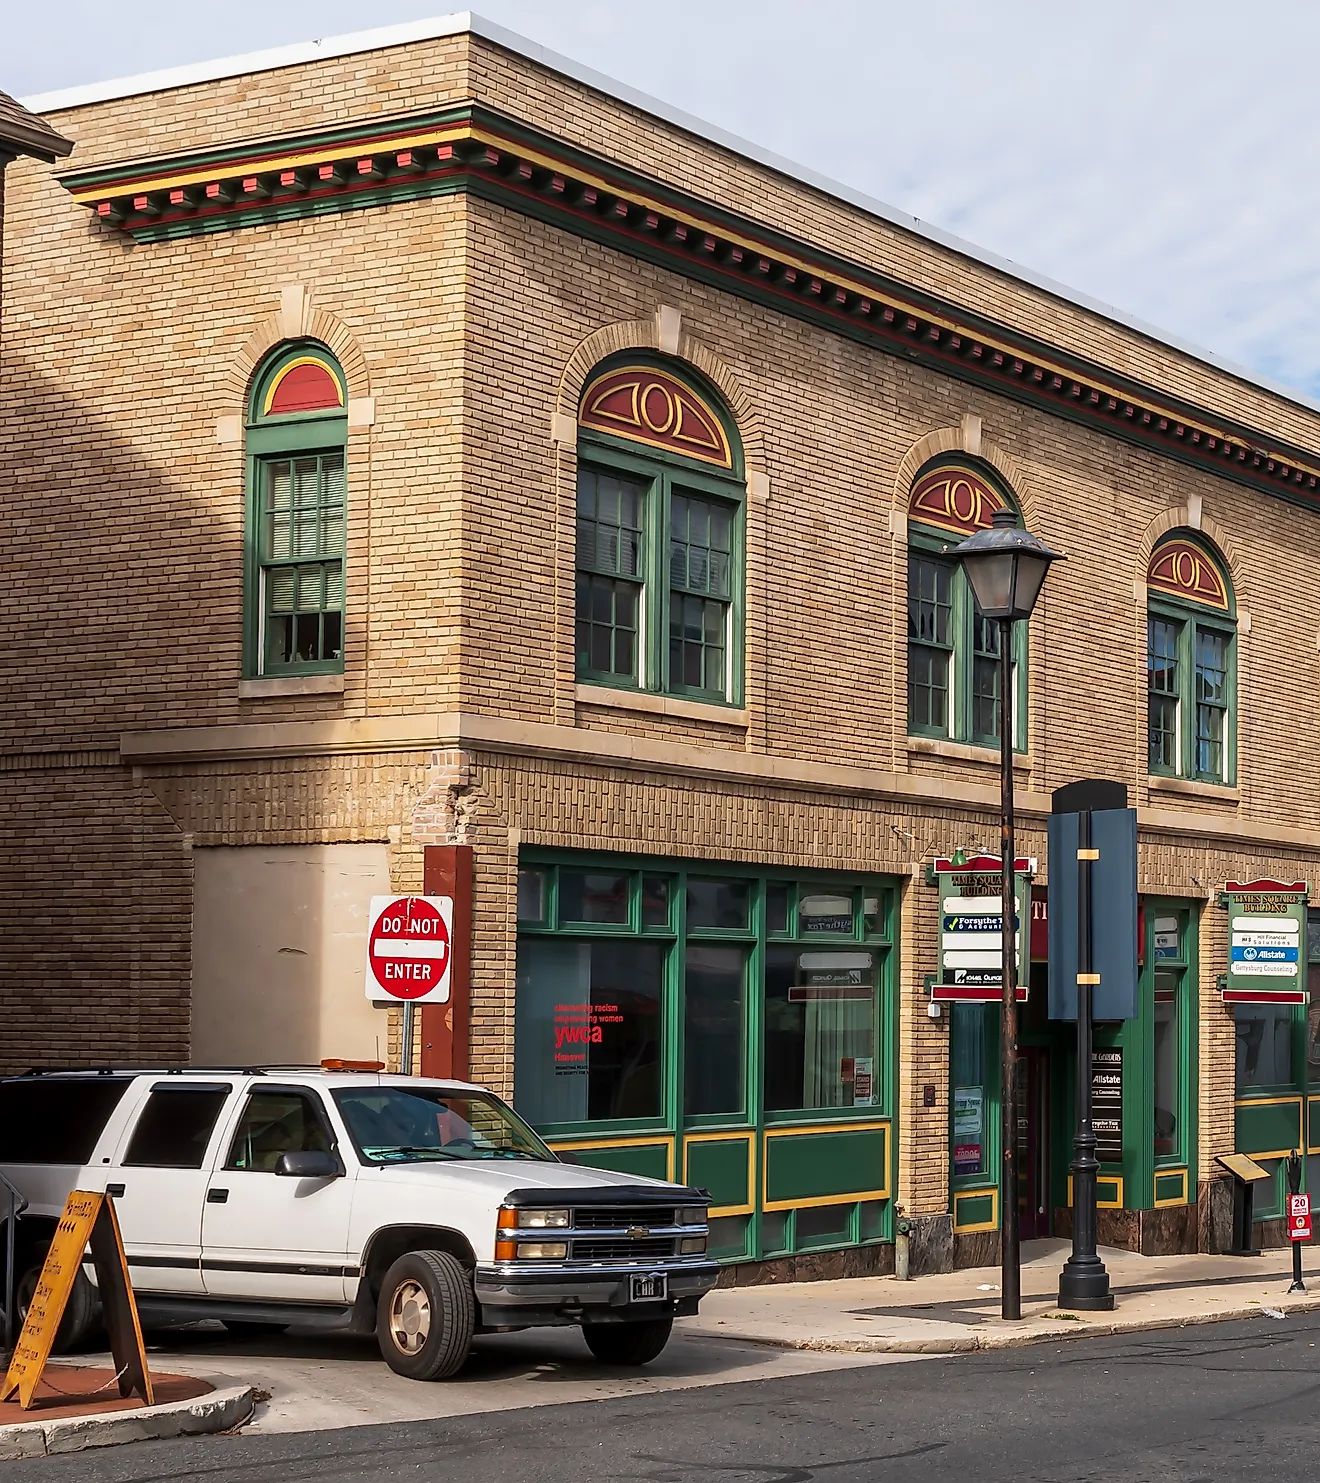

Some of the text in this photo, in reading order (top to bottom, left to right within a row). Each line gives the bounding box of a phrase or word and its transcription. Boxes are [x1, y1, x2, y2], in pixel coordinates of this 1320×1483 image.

[952, 875, 1002, 886] TIMES SQUA
[1234, 895, 1298, 905] TIMES SQUARE
[1243, 904, 1287, 913] BUILDING
[382, 917, 440, 934] DO NOT
[959, 917, 997, 926] Forsythe
[1258, 951, 1286, 959] Allstate
[385, 963, 431, 980] ENTER
[1235, 964, 1293, 974] Gettysburg Counseling
[594, 1003, 618, 1012] racism
[554, 1025, 603, 1049] ywca
[1093, 1075, 1121, 1084] Allstate
[1294, 1199, 1305, 1207] 20
